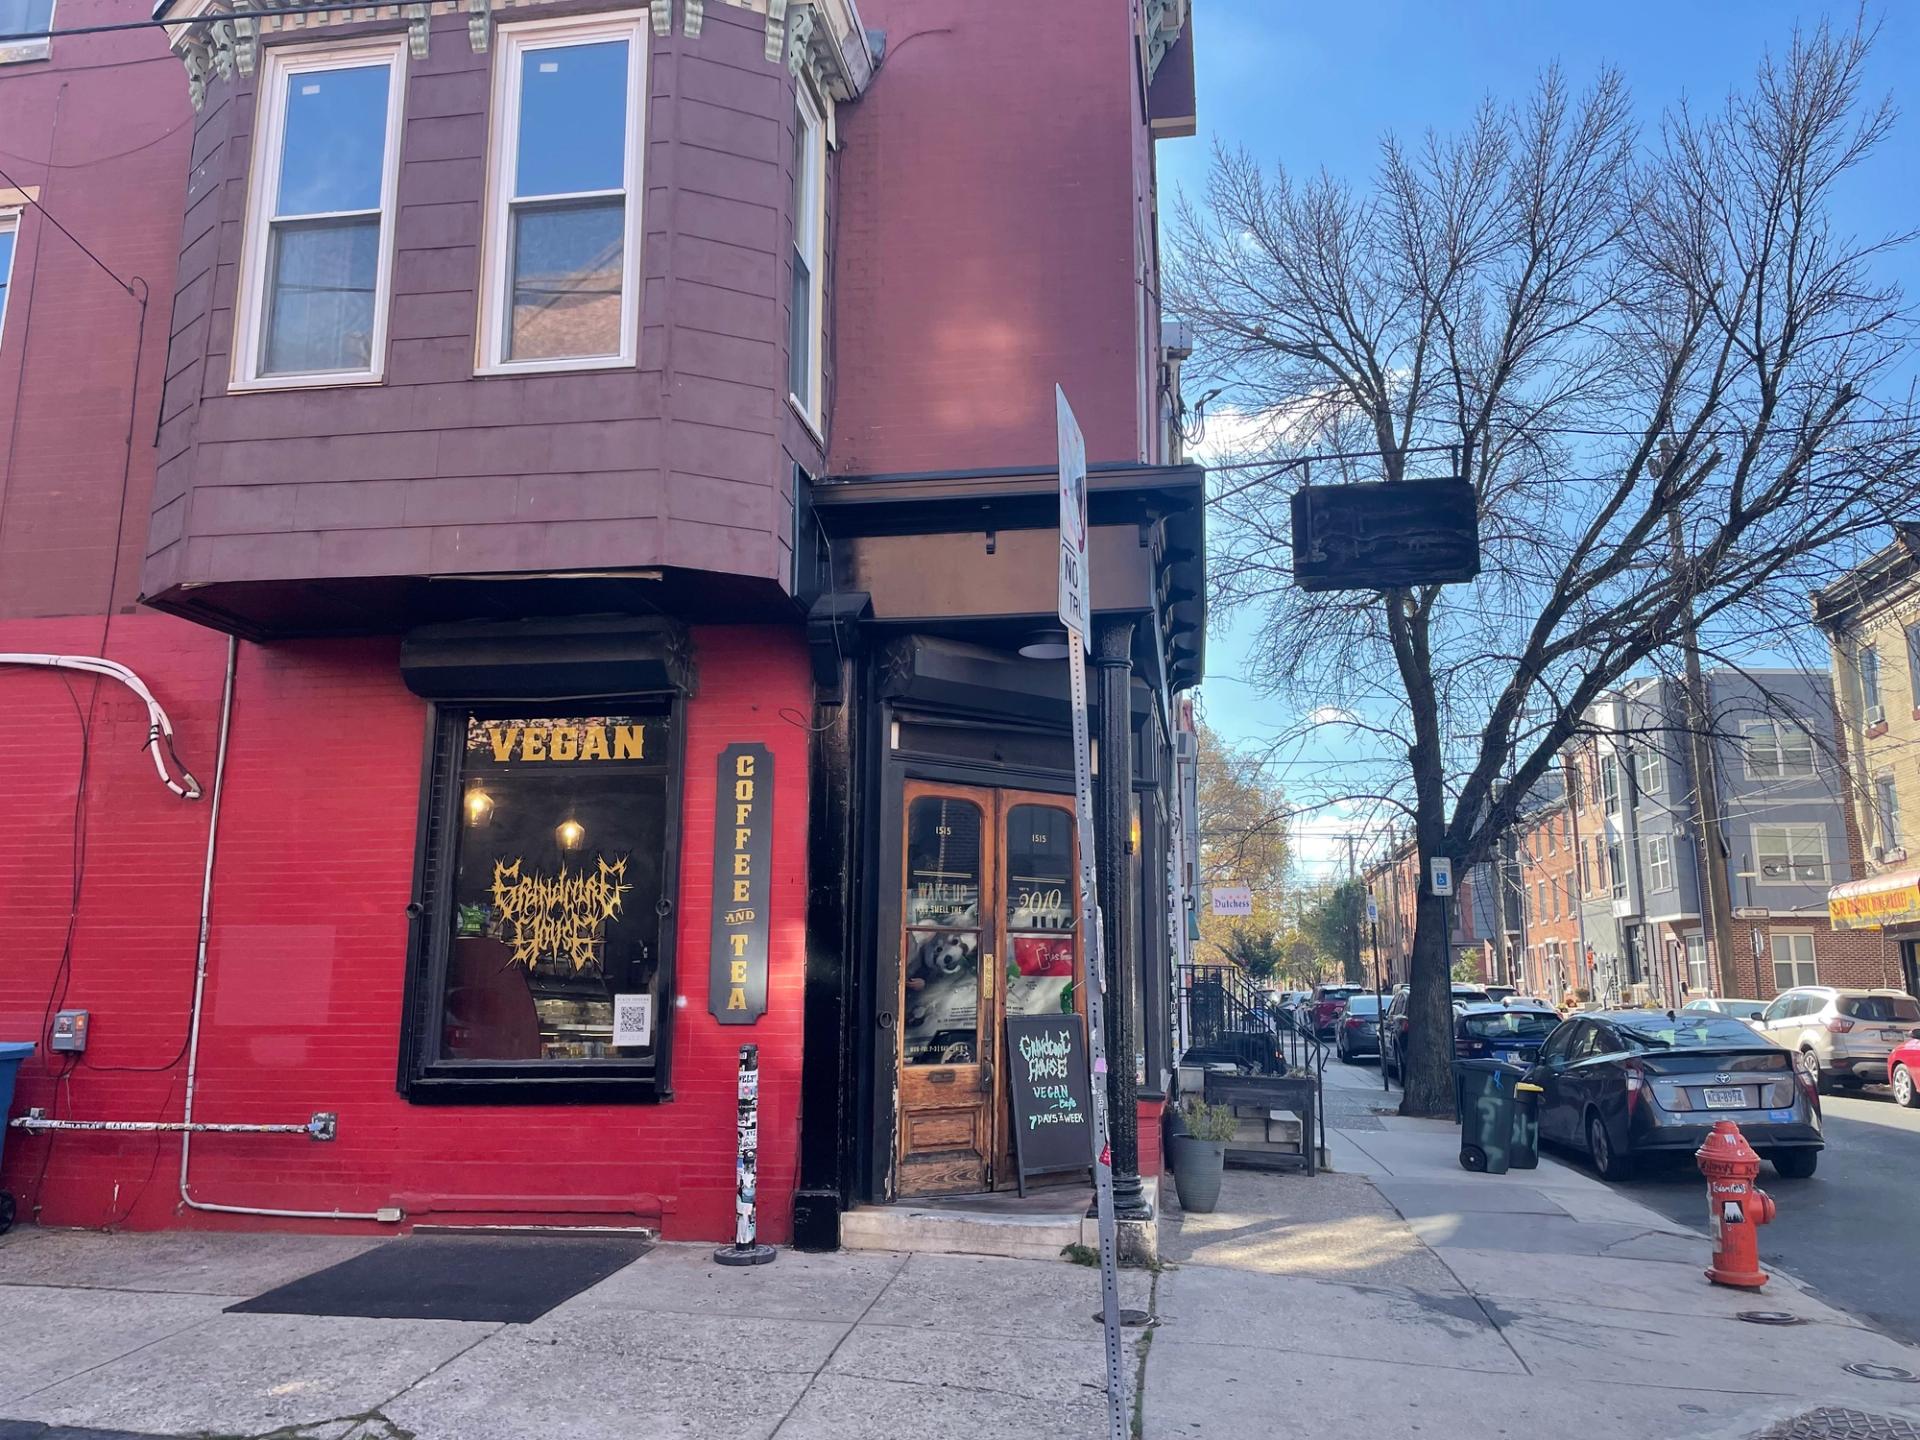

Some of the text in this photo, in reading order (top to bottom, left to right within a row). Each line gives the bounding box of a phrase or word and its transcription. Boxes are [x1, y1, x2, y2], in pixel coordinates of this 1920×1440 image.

[1065, 553, 1079, 588] NO
[488, 725, 645, 761] VEGAN
[732, 755, 755, 902] COFFEE
[935, 826, 952, 836] 1515
[1032, 834, 1047, 843] 1515
[918, 882, 968, 902] WAKE UP
[1019, 889, 1062, 916] 2010
[724, 908, 755, 926] AND
[726, 934, 749, 1010] TEA
[1033, 1084, 1069, 1099] VEGAN
[1029, 1115, 1037, 1130] 7
[1037, 1113, 1058, 1125] DAYS
[1064, 1112, 1085, 1124] WEEK
